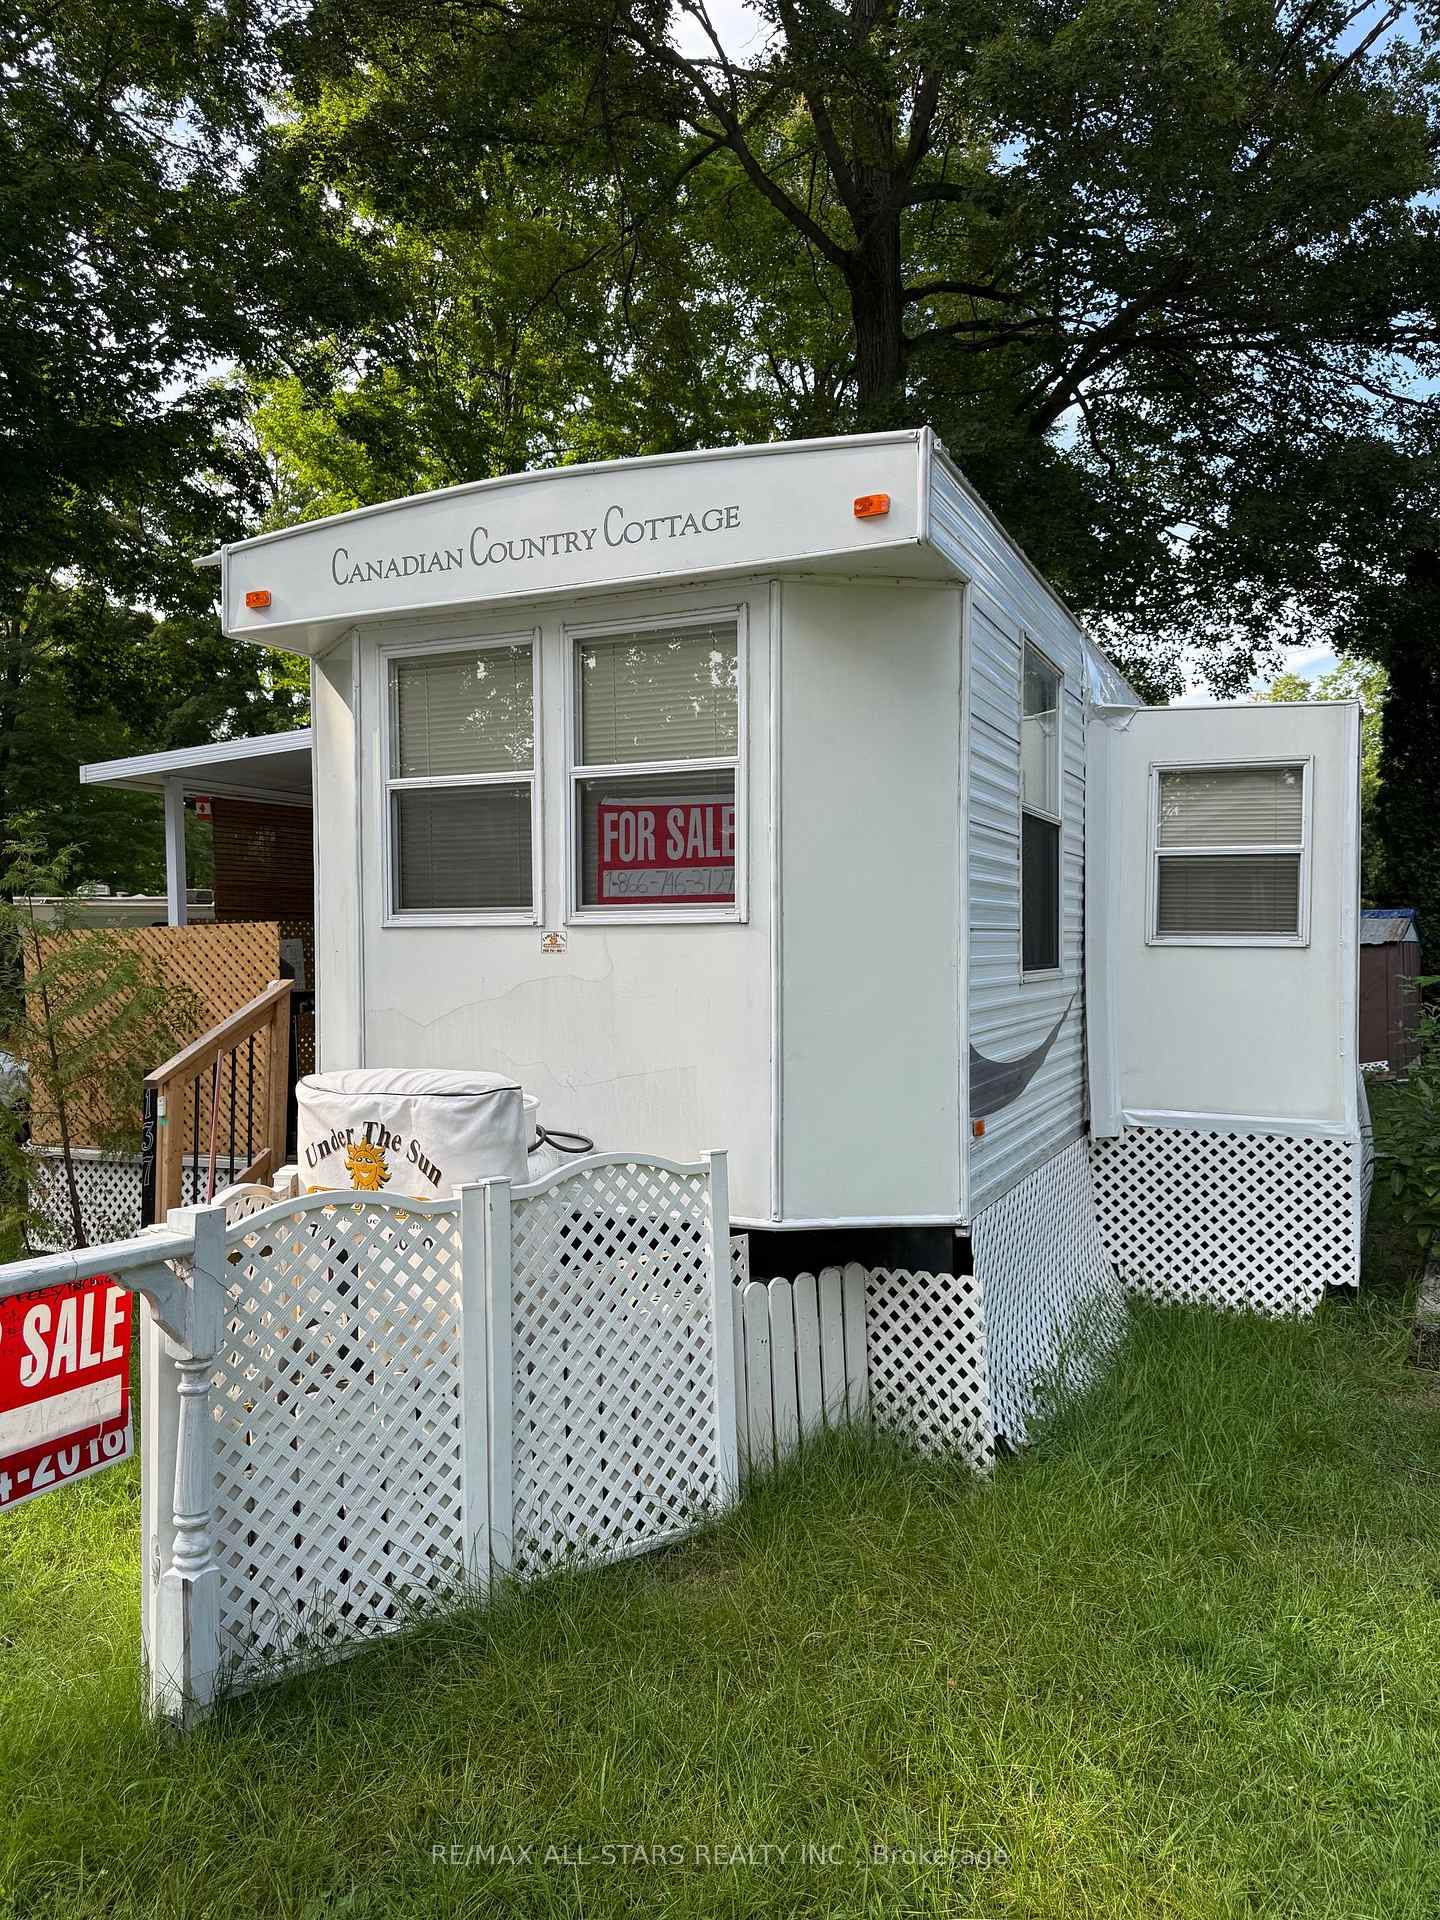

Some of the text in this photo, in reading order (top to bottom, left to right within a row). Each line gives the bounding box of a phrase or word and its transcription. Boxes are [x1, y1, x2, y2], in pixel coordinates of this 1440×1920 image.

[331, 505, 741, 586] CANADIAN COUNTRY COTTAGE
[603, 805, 736, 863] FOR SALE
[304, 1120, 443, 1189] Under The Sun
[20, 1285, 127, 1387] SALE
